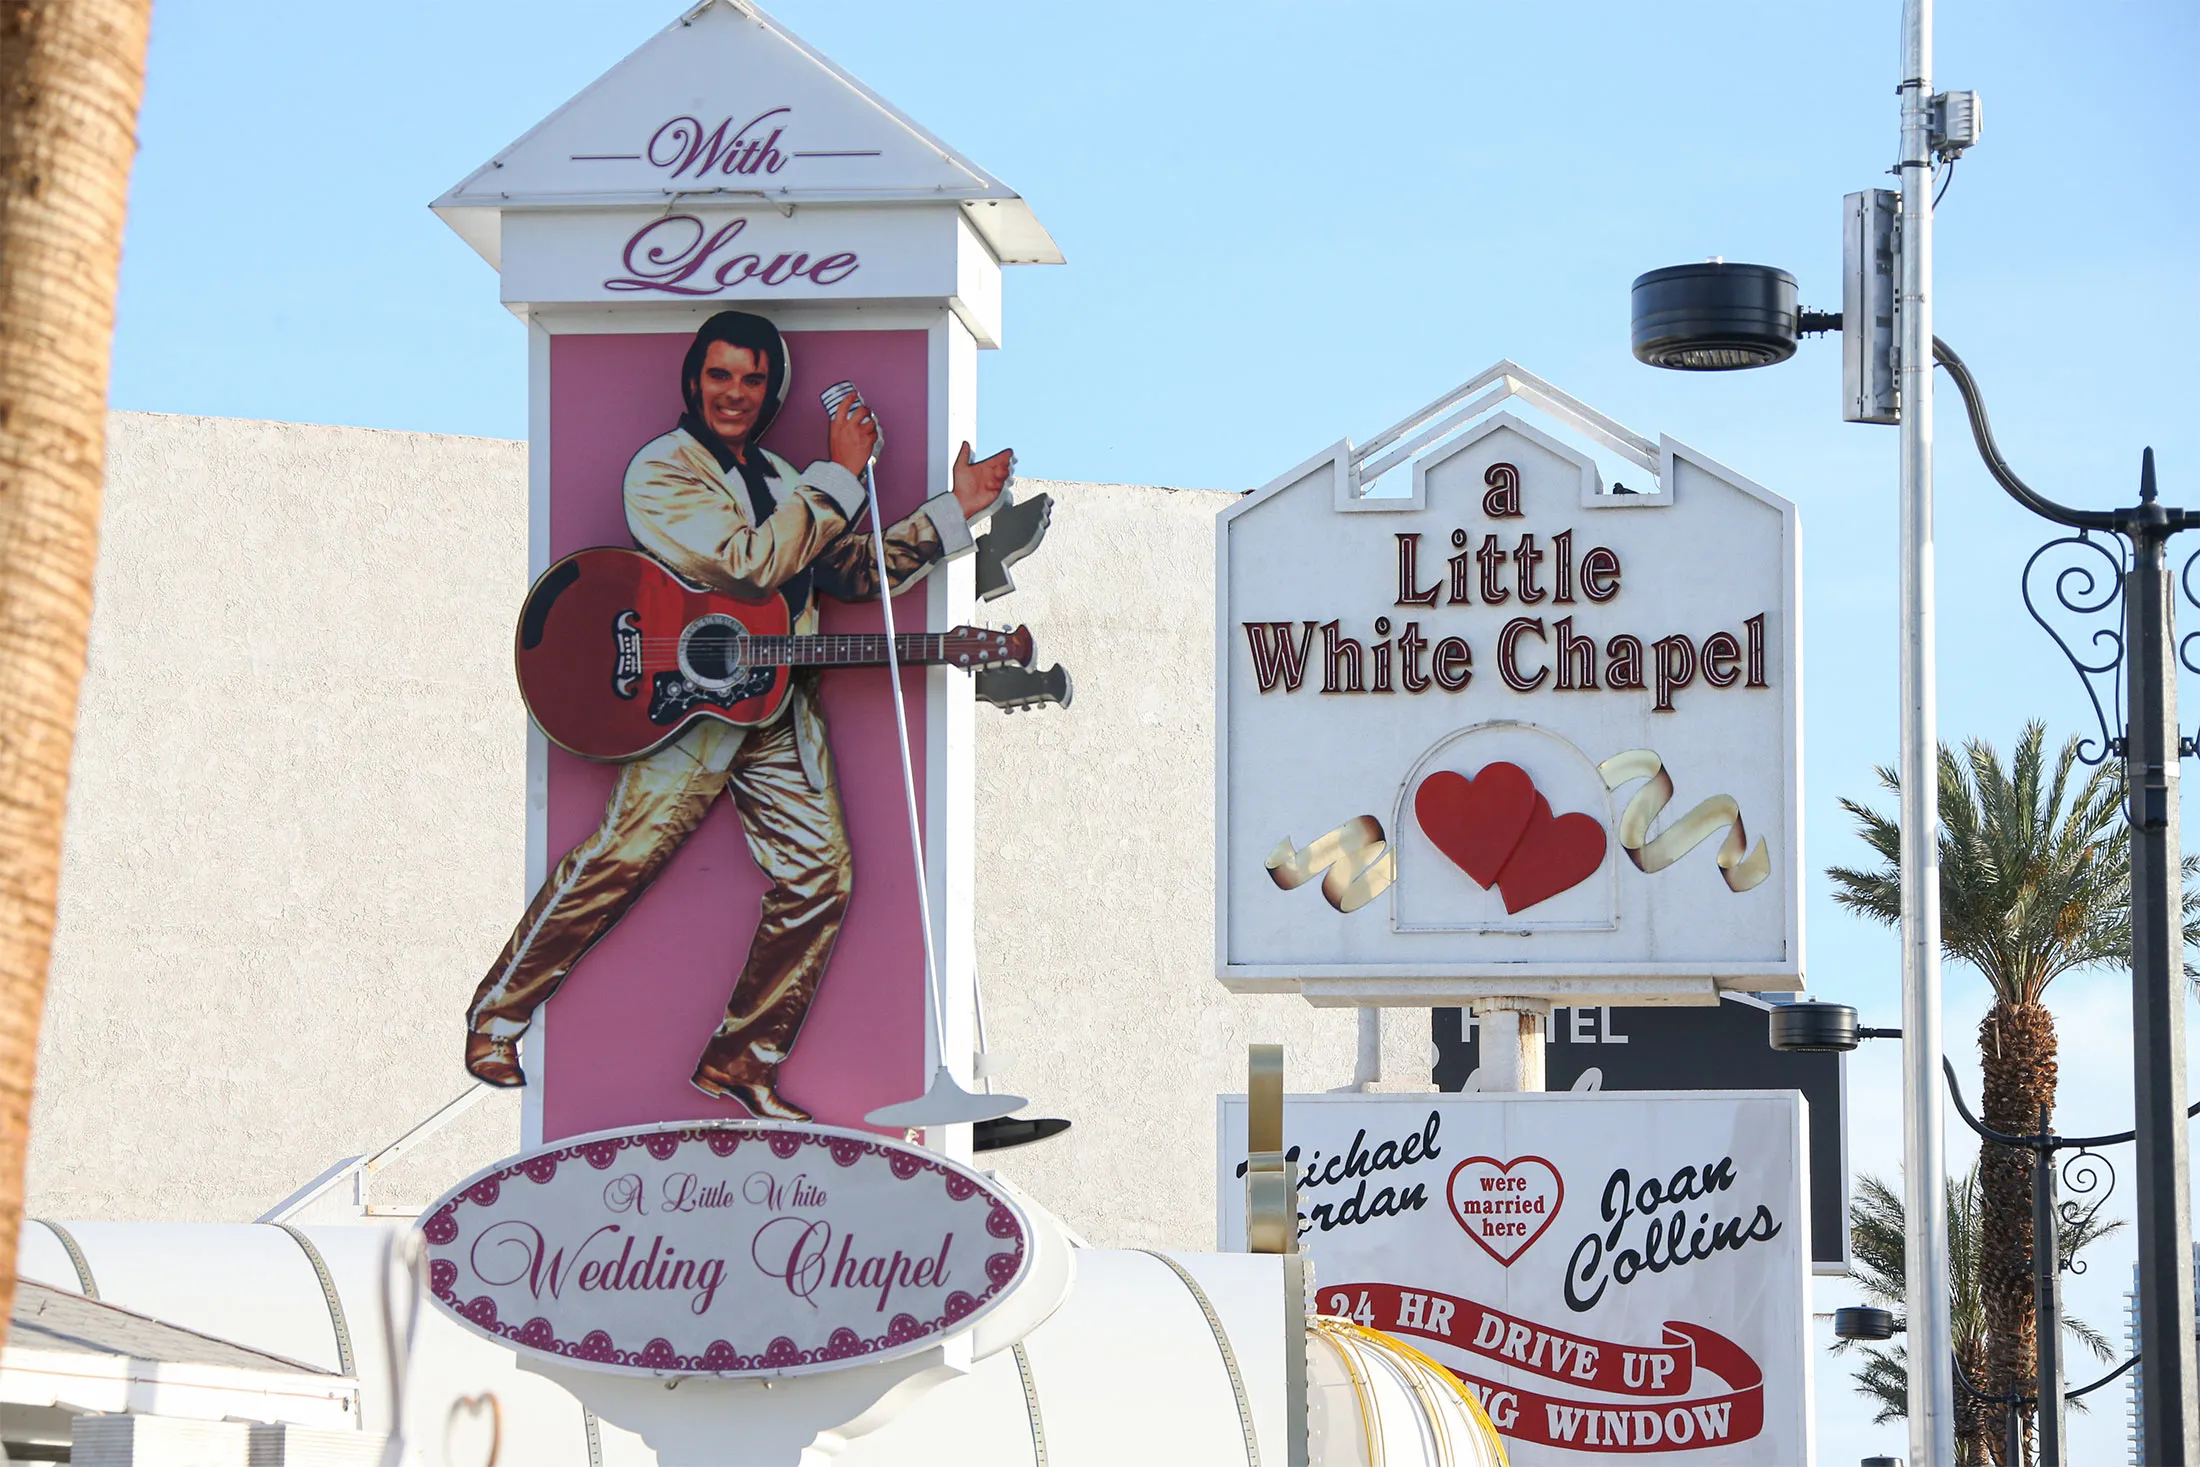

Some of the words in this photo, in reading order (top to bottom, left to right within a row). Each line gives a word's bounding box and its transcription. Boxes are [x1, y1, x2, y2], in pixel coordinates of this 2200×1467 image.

[648, 105, 791, 179] With
[603, 214, 859, 296] Love
[1481, 461, 1524, 518] a
[1394, 527, 1622, 609] Little
[1242, 616, 1474, 694] White
[1496, 611, 1770, 712] Chapel
[1236, 1110, 1442, 1191] ichael
[1480, 1174, 1527, 1192] were
[603, 1173, 649, 1215] A
[661, 1173, 735, 1212] Little
[742, 1173, 828, 1212] White
[1297, 1179, 1429, 1239] rdan
[1463, 1195, 1545, 1214] married
[1482, 1217, 1528, 1237] here
[1601, 1156, 1737, 1252] Joan
[470, 1220, 728, 1315] Wedding
[752, 1216, 955, 1313] Chapel
[1563, 1204, 1783, 1313] Collins
[1330, 1291, 1375, 1328] 24
[1396, 1291, 1455, 1337] HR
[1473, 1311, 1600, 1381] DRIVE
[1623, 1352, 1676, 1390] UP
[1545, 1402, 1733, 1447] WINDOW
